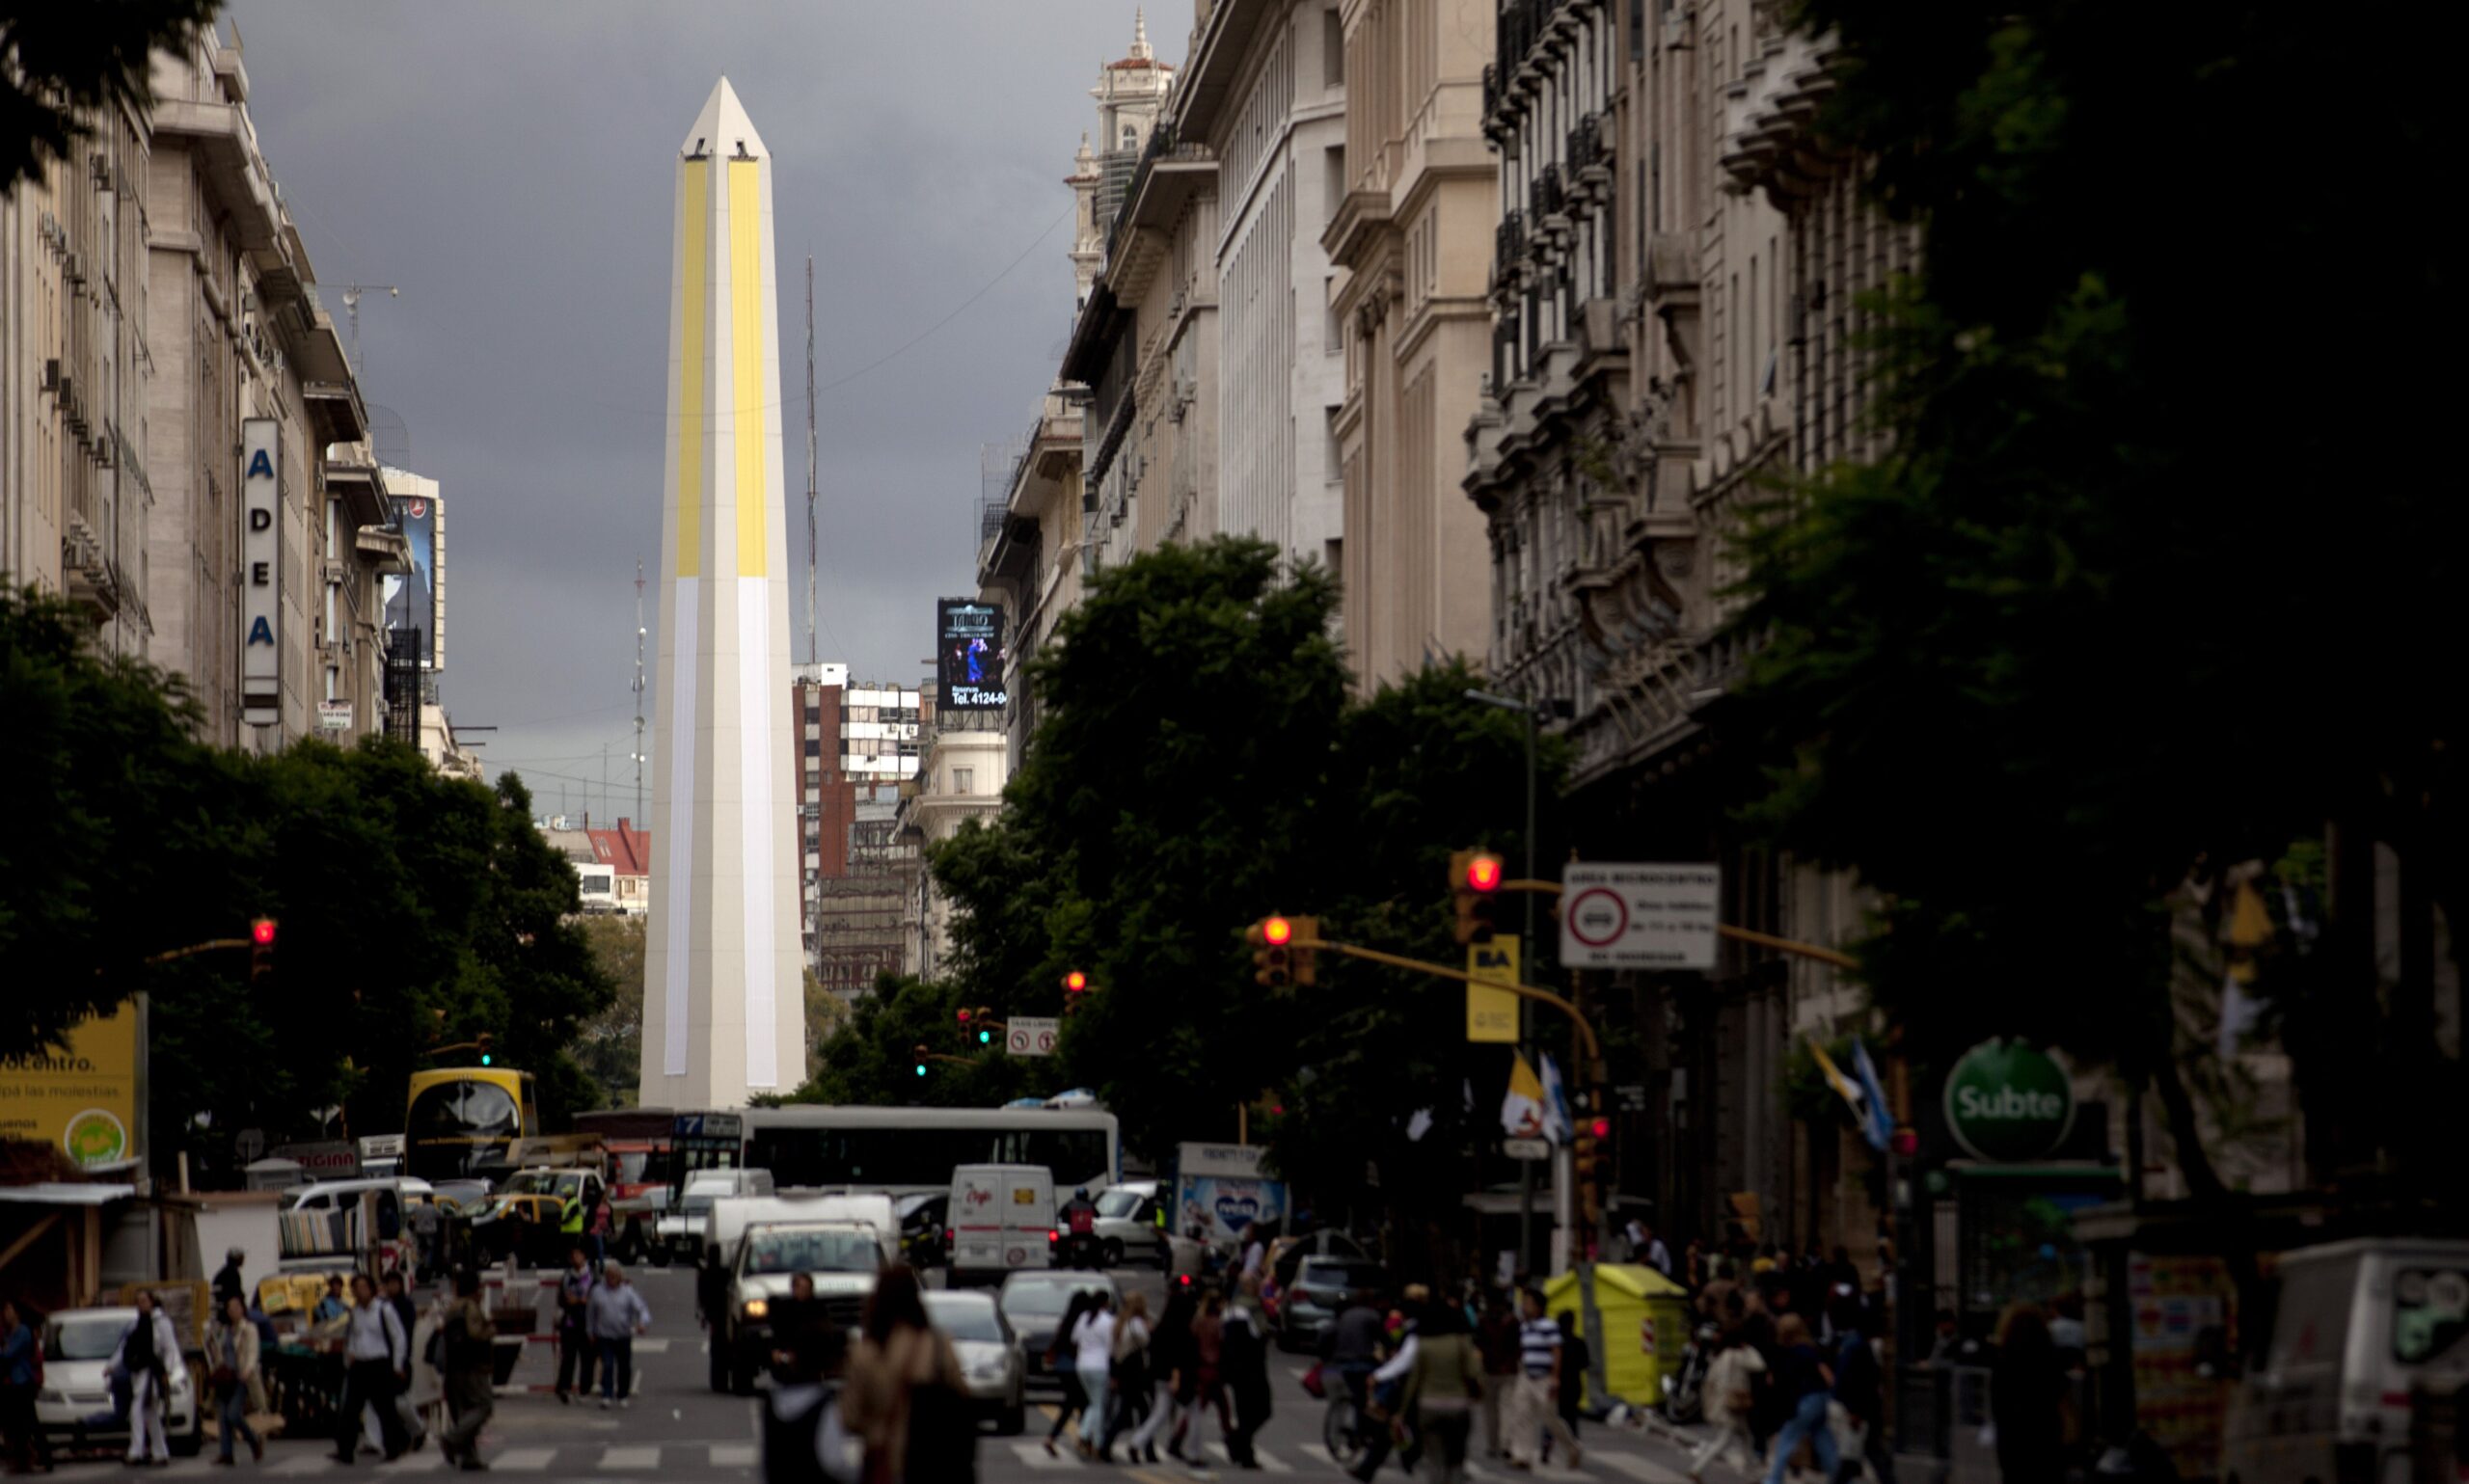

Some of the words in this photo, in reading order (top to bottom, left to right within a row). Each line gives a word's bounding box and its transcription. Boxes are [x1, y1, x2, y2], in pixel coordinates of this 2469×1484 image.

[247, 448, 274, 645] ADEA
[952, 692, 969, 705] Tel.
[971, 692, 1007, 705] 4124-9
[1477, 950, 1511, 967] BA
[1958, 1084, 2062, 1120] Subte
[683, 1116, 702, 1135] 7
